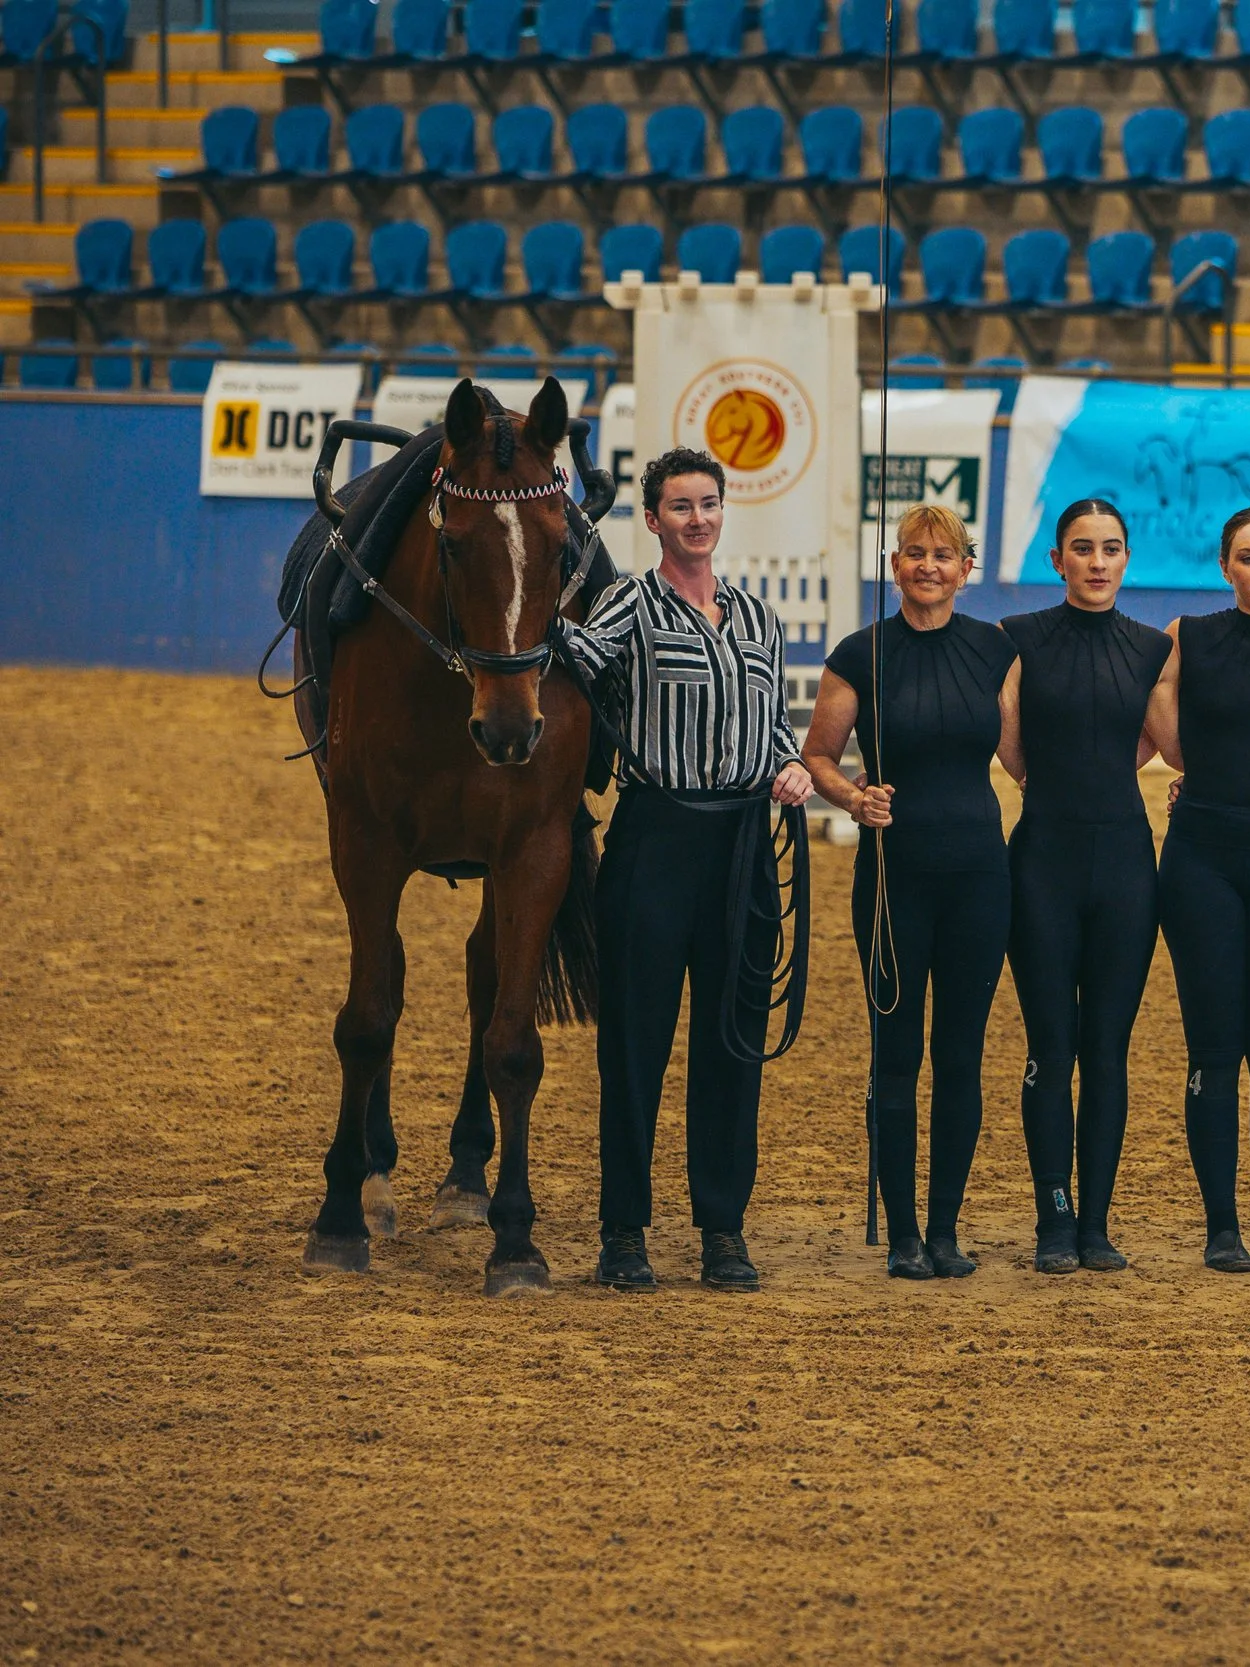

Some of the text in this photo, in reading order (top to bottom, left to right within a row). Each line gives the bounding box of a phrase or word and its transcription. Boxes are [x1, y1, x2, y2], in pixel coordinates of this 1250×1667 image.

[268, 410, 337, 449] DCT
[1024, 1060, 1038, 1087] 2
[1189, 1069, 1202, 1095] 4
